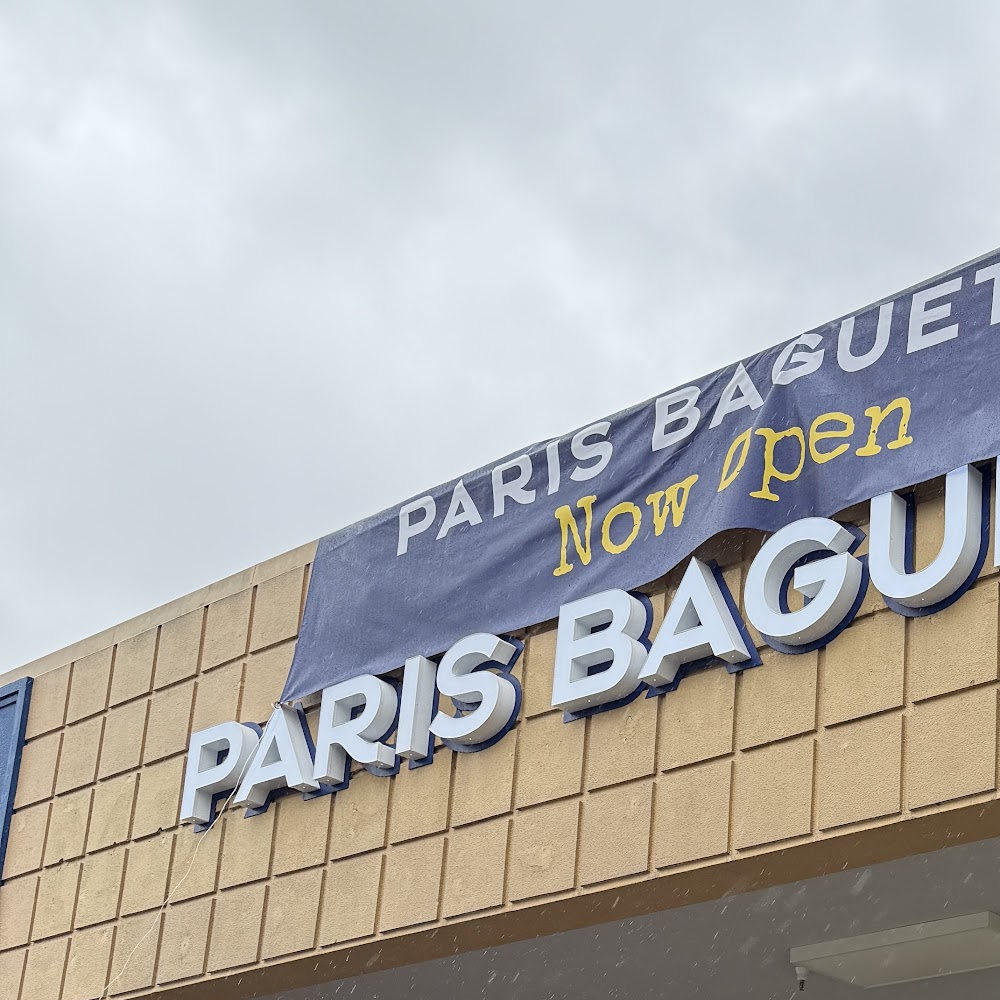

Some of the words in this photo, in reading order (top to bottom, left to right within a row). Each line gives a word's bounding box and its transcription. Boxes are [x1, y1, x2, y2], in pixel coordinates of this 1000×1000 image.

[396, 421, 613, 556] PARIS
[552, 474, 699, 577] Now
[717, 396, 913, 502] Open
[179, 632, 521, 828] PARIS
